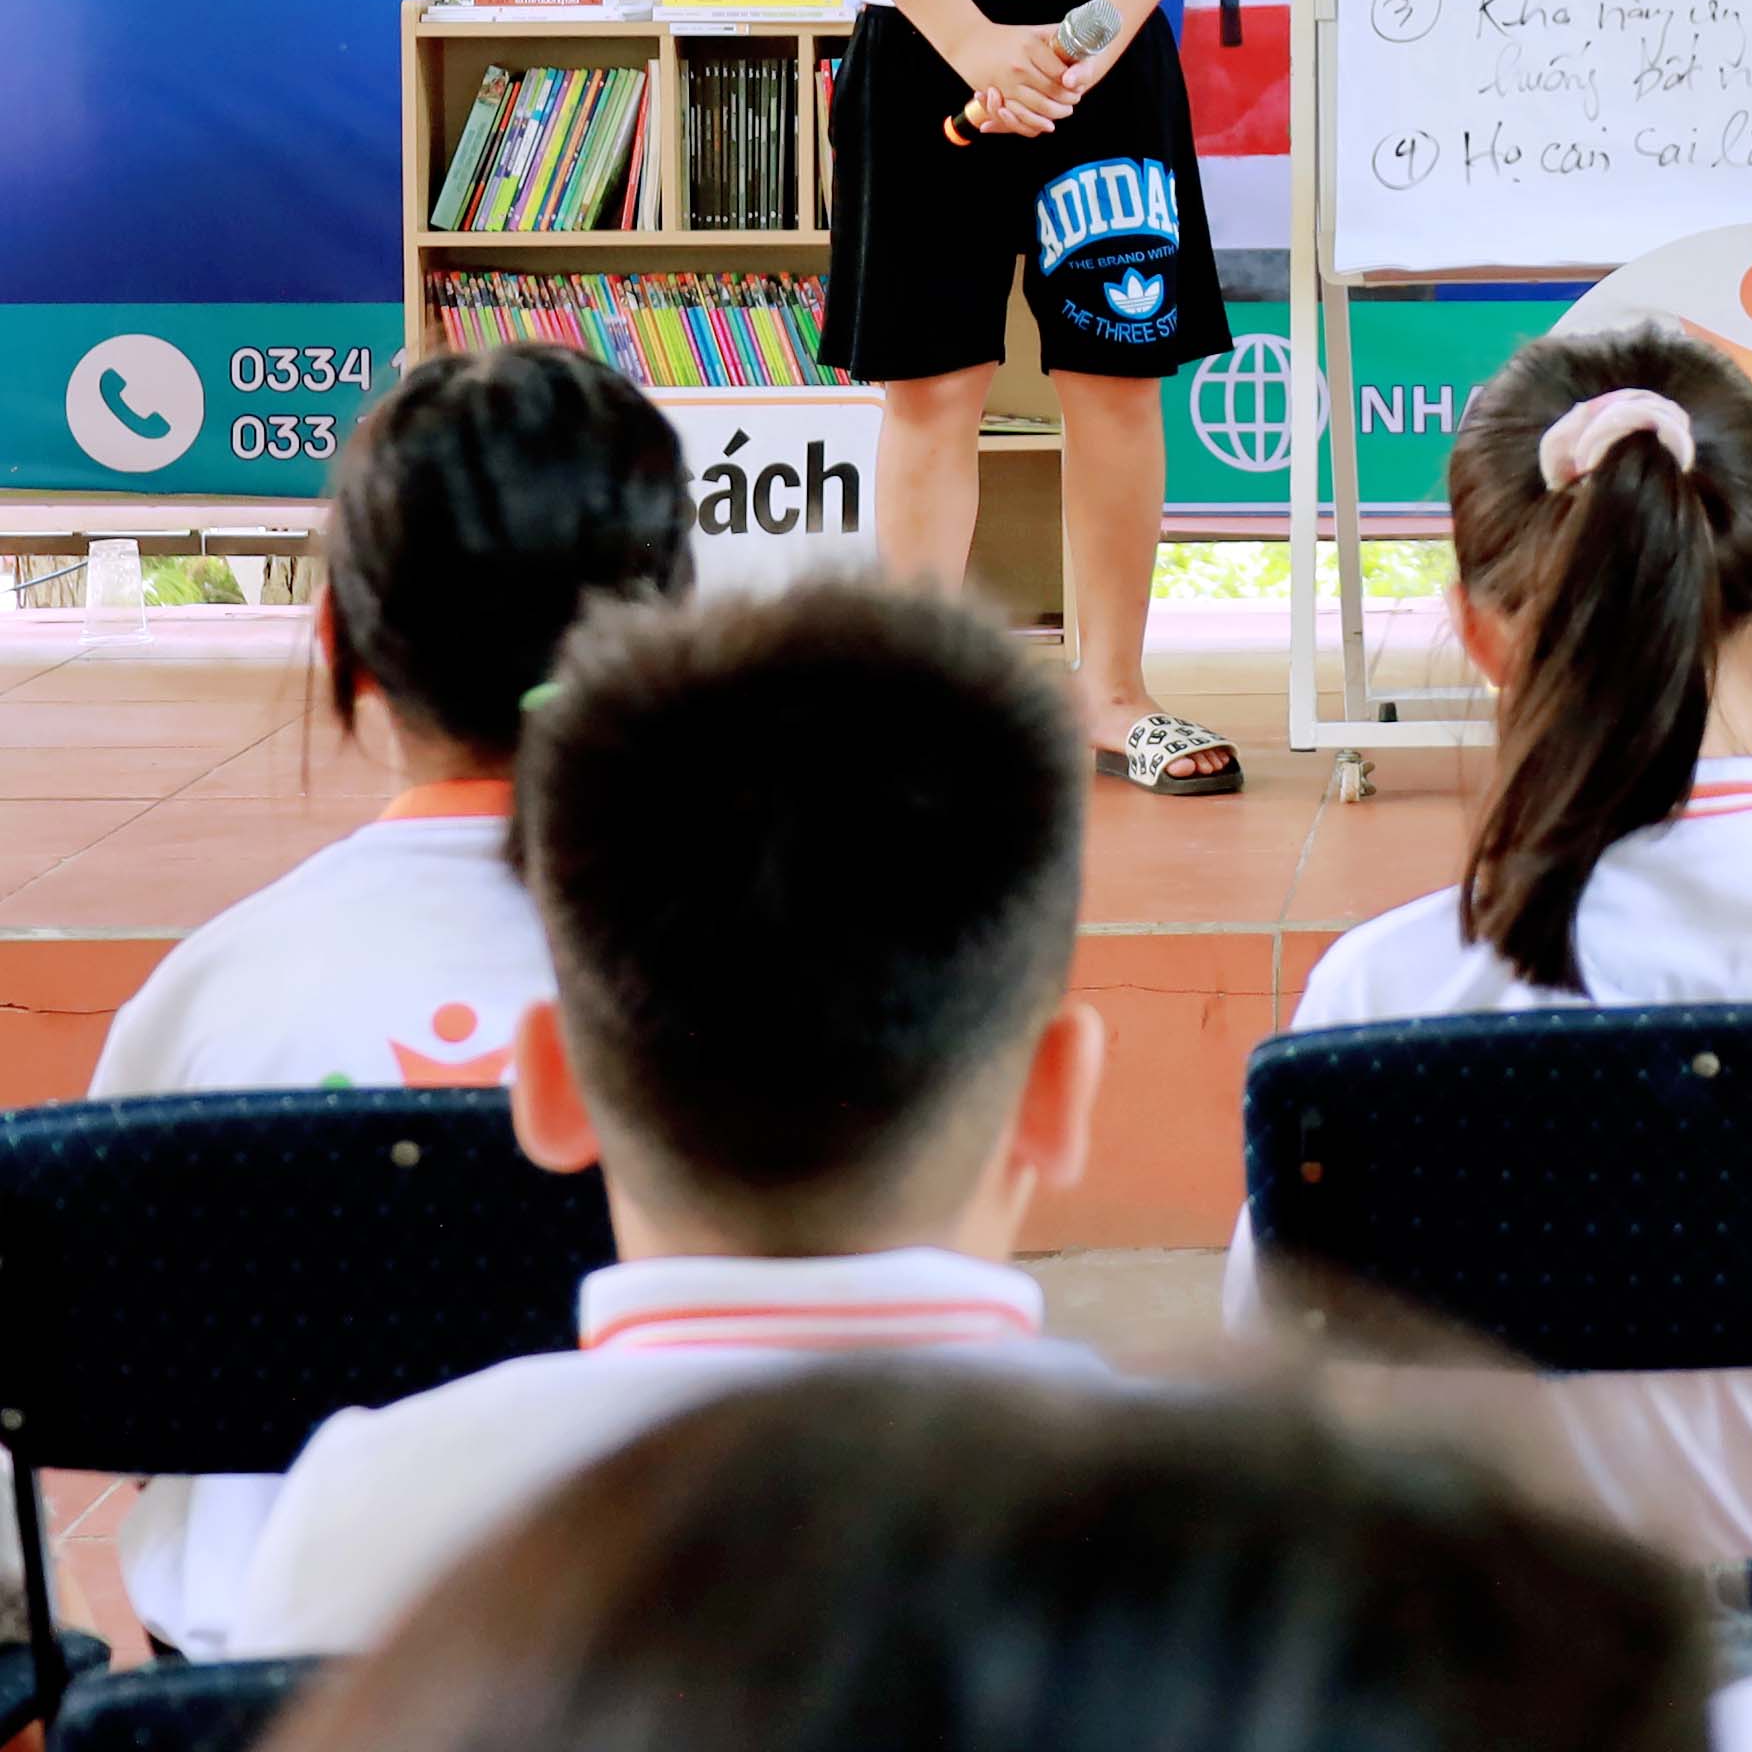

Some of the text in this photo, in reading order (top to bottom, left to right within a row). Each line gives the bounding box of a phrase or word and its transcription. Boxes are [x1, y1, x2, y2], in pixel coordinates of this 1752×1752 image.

[1068, 257, 1095, 271] THE
[1098, 251, 1145, 269] BRAND
[1062, 298, 1094, 331] THE
[1095, 315, 1157, 344] THREE
[230, 346, 371, 393] 0334
[231, 414, 338, 461] 033
